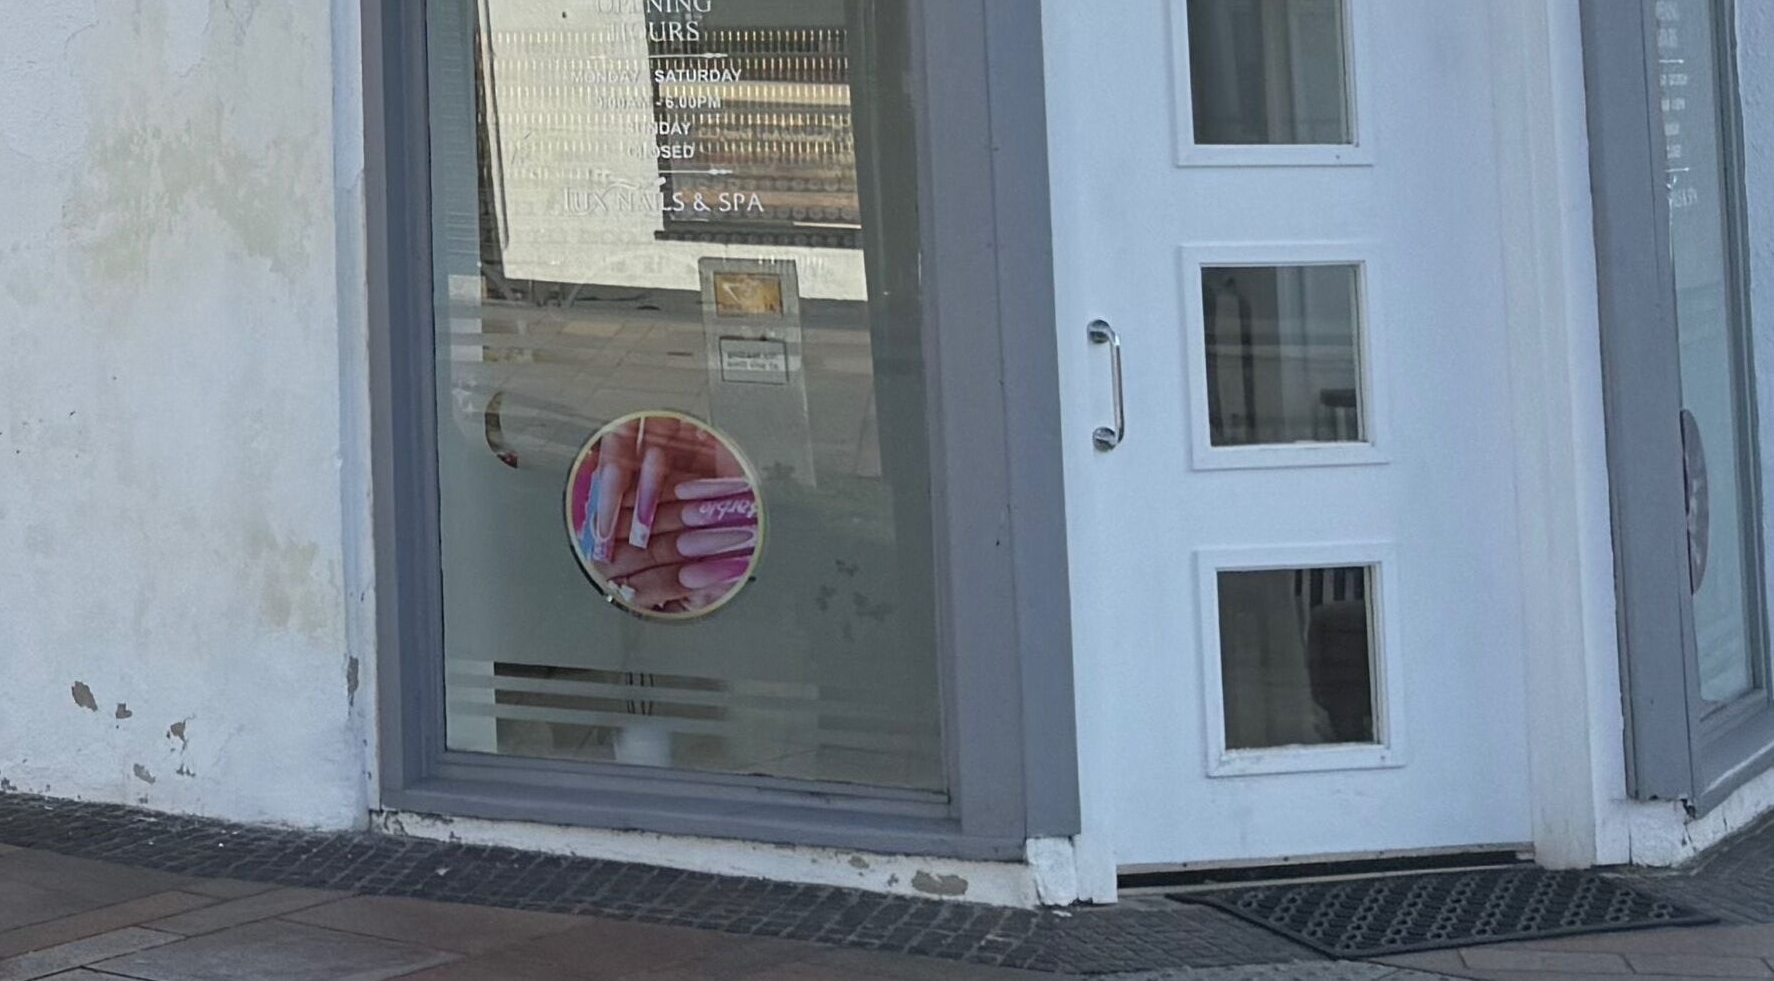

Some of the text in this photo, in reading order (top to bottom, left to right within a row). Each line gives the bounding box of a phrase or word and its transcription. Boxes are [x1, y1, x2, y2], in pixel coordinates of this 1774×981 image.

[609, 20, 700, 43] HOURS
[571, 68, 742, 84] MONDAY SATURDAY
[665, 96, 722, 109] 6.00PM
[628, 121, 692, 136] SUNDAY
[628, 144, 695, 159] CLOSED
[617, 189, 685, 212] NAILS
[693, 192, 711, 212] &
[718, 191, 765, 213] SPA
